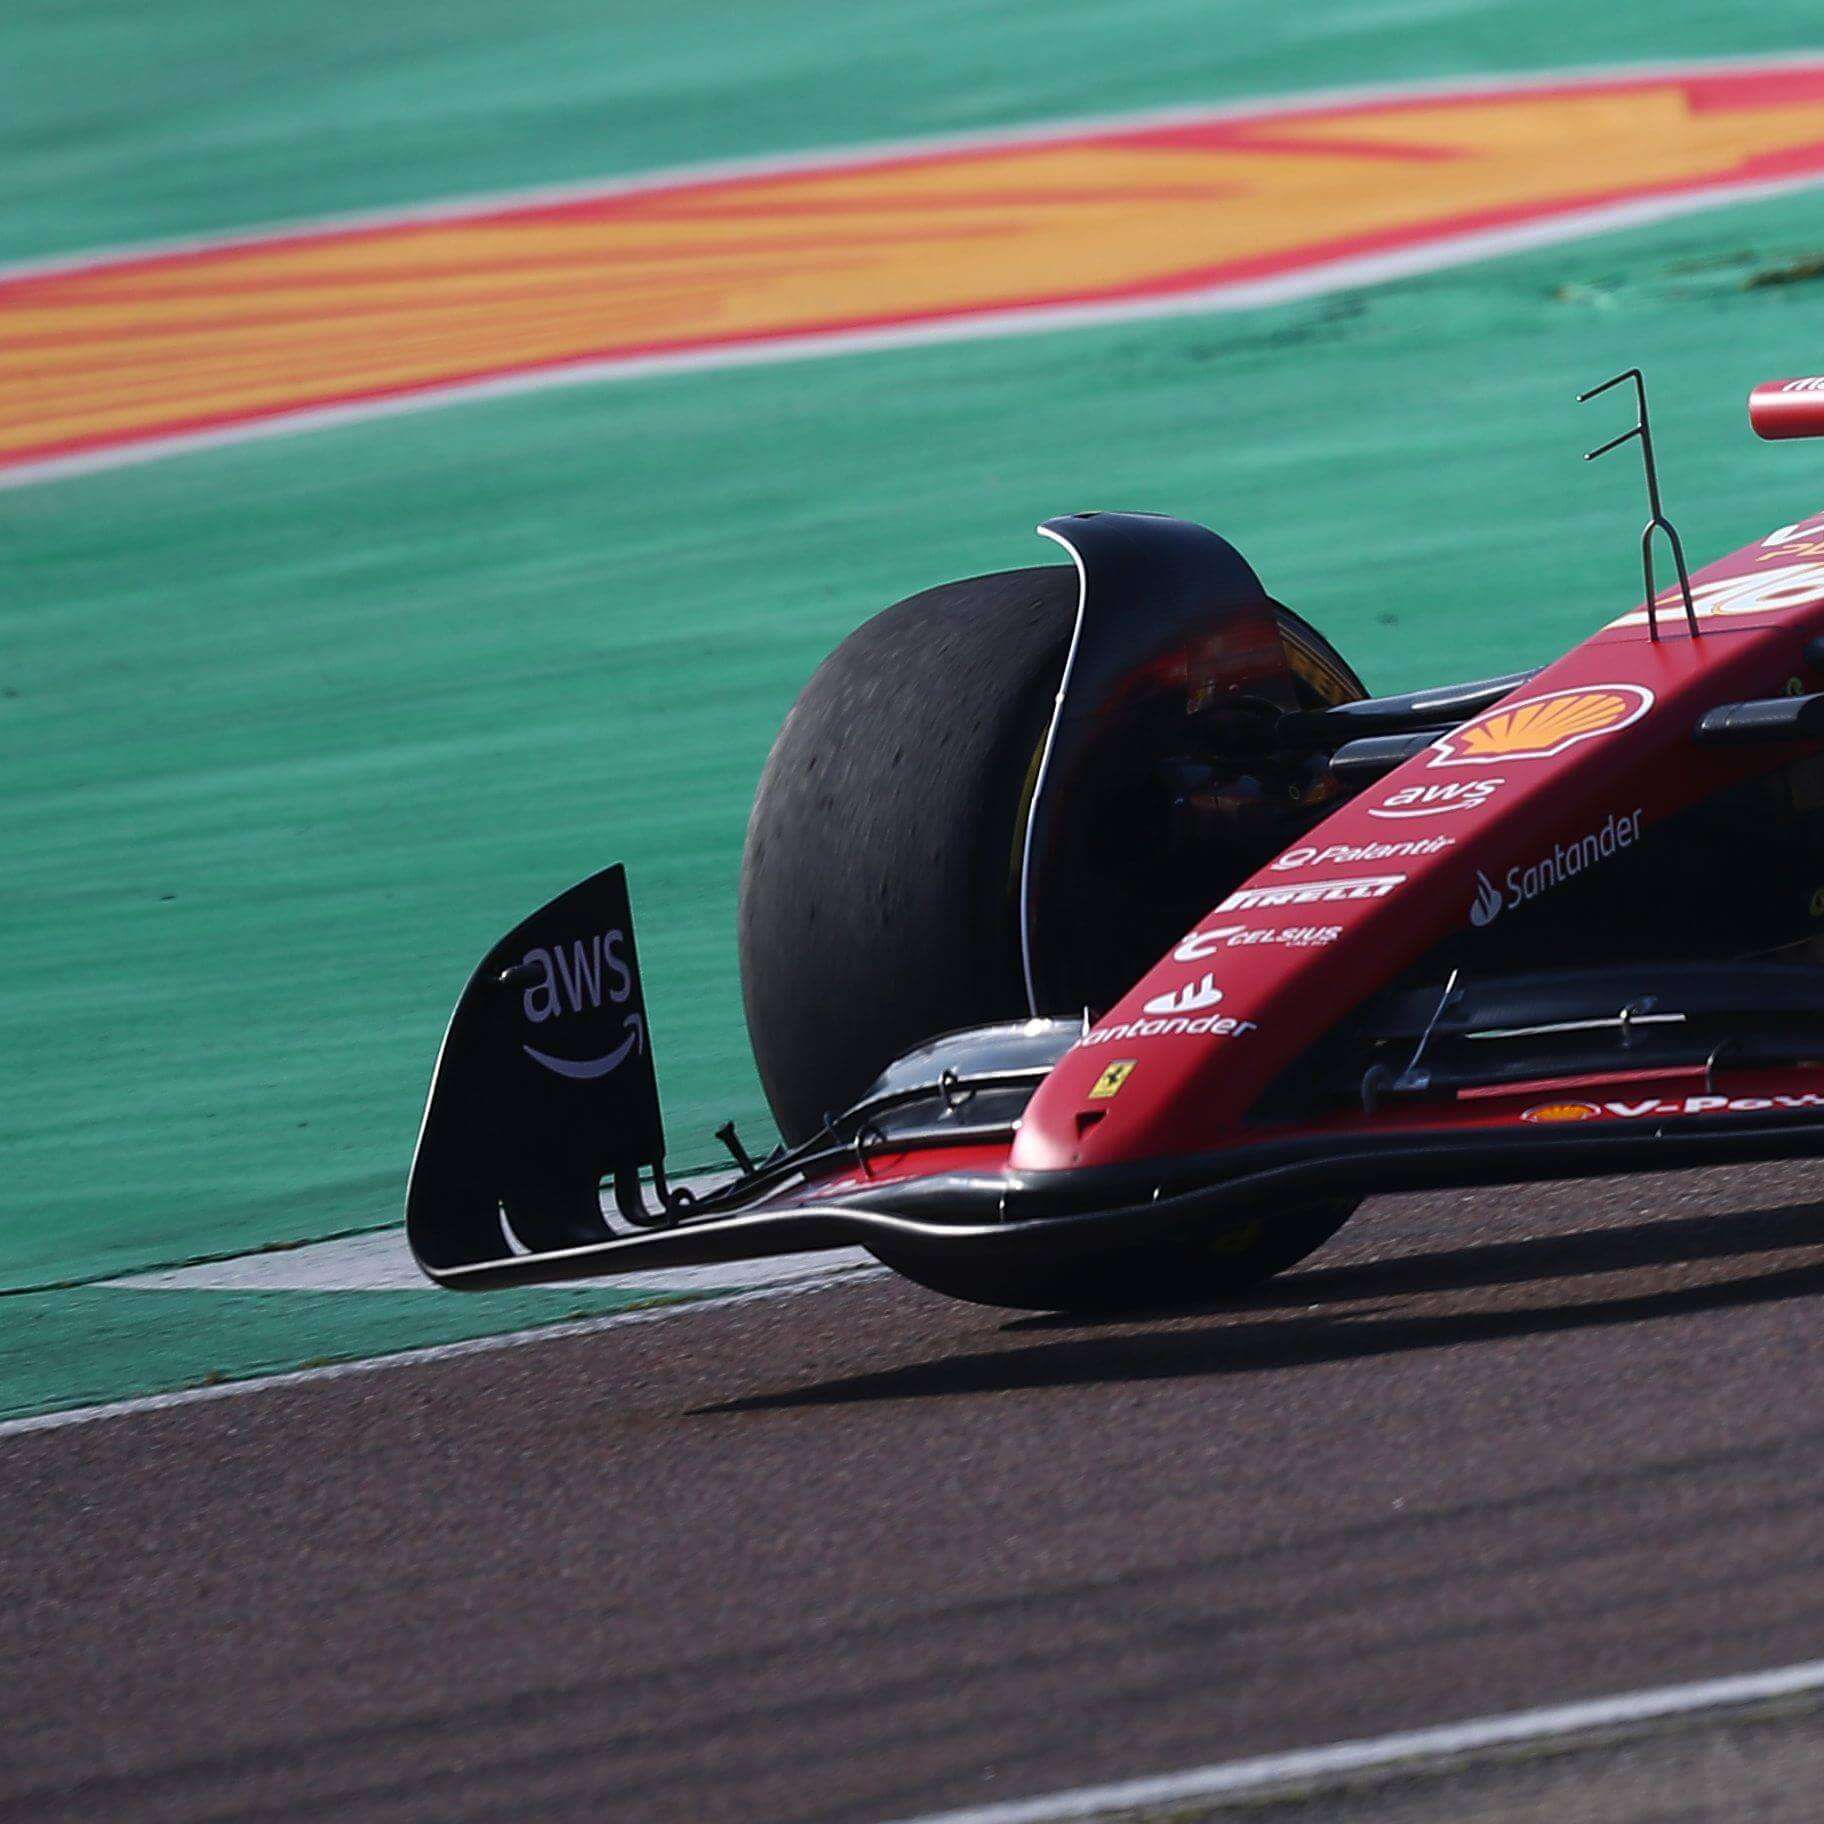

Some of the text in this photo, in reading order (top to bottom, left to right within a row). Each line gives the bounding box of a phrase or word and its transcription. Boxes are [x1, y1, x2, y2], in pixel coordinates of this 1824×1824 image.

[1383, 778, 1506, 807] aws
[1310, 834, 1457, 866] Palantir
[1506, 807, 1643, 910] Santander
[1213, 874, 1407, 914] PIRELLI
[1226, 926, 1344, 948] CELSIUS
[521, 928, 633, 1024] aws
